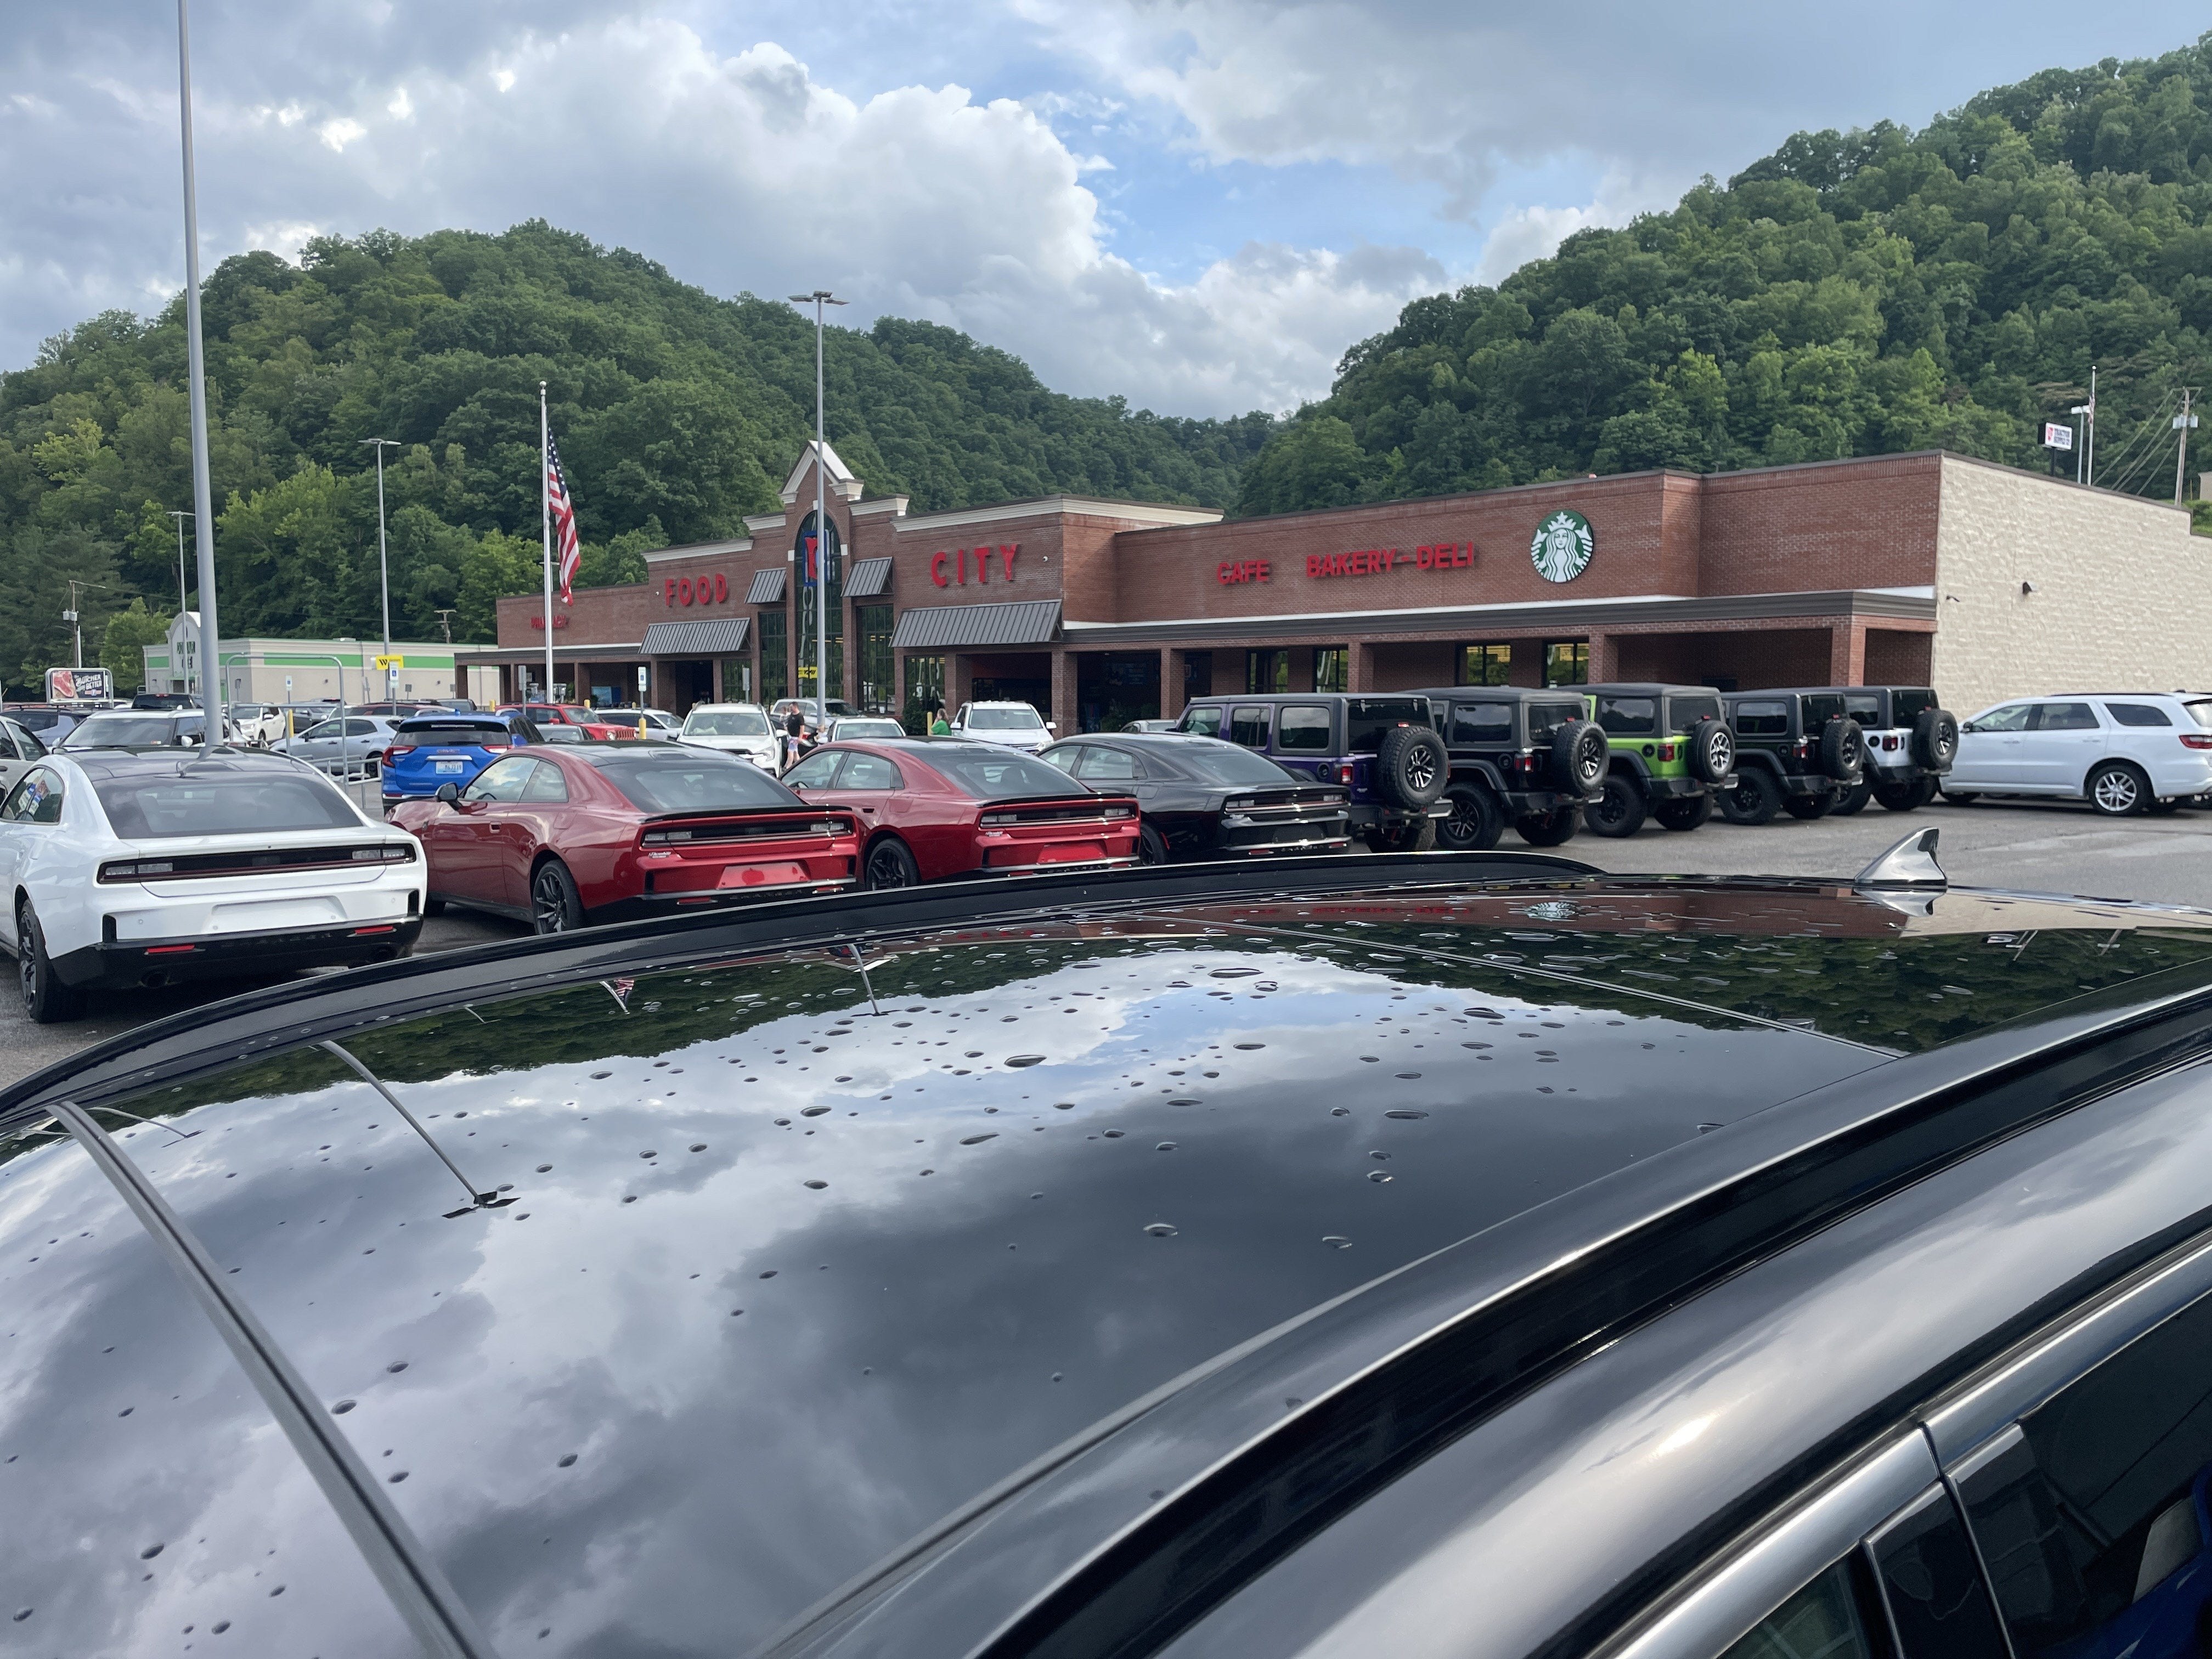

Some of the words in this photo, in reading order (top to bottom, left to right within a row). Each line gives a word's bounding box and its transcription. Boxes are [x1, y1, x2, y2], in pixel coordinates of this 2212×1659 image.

[1217, 560, 1269, 585] CAFE
[1306, 548, 1397, 578] BAKERY
[1417, 541, 1475, 569] DELI
[665, 573, 727, 607] FOOD
[931, 544, 1018, 588] CITY
[86, 680, 103, 690] BETTER
